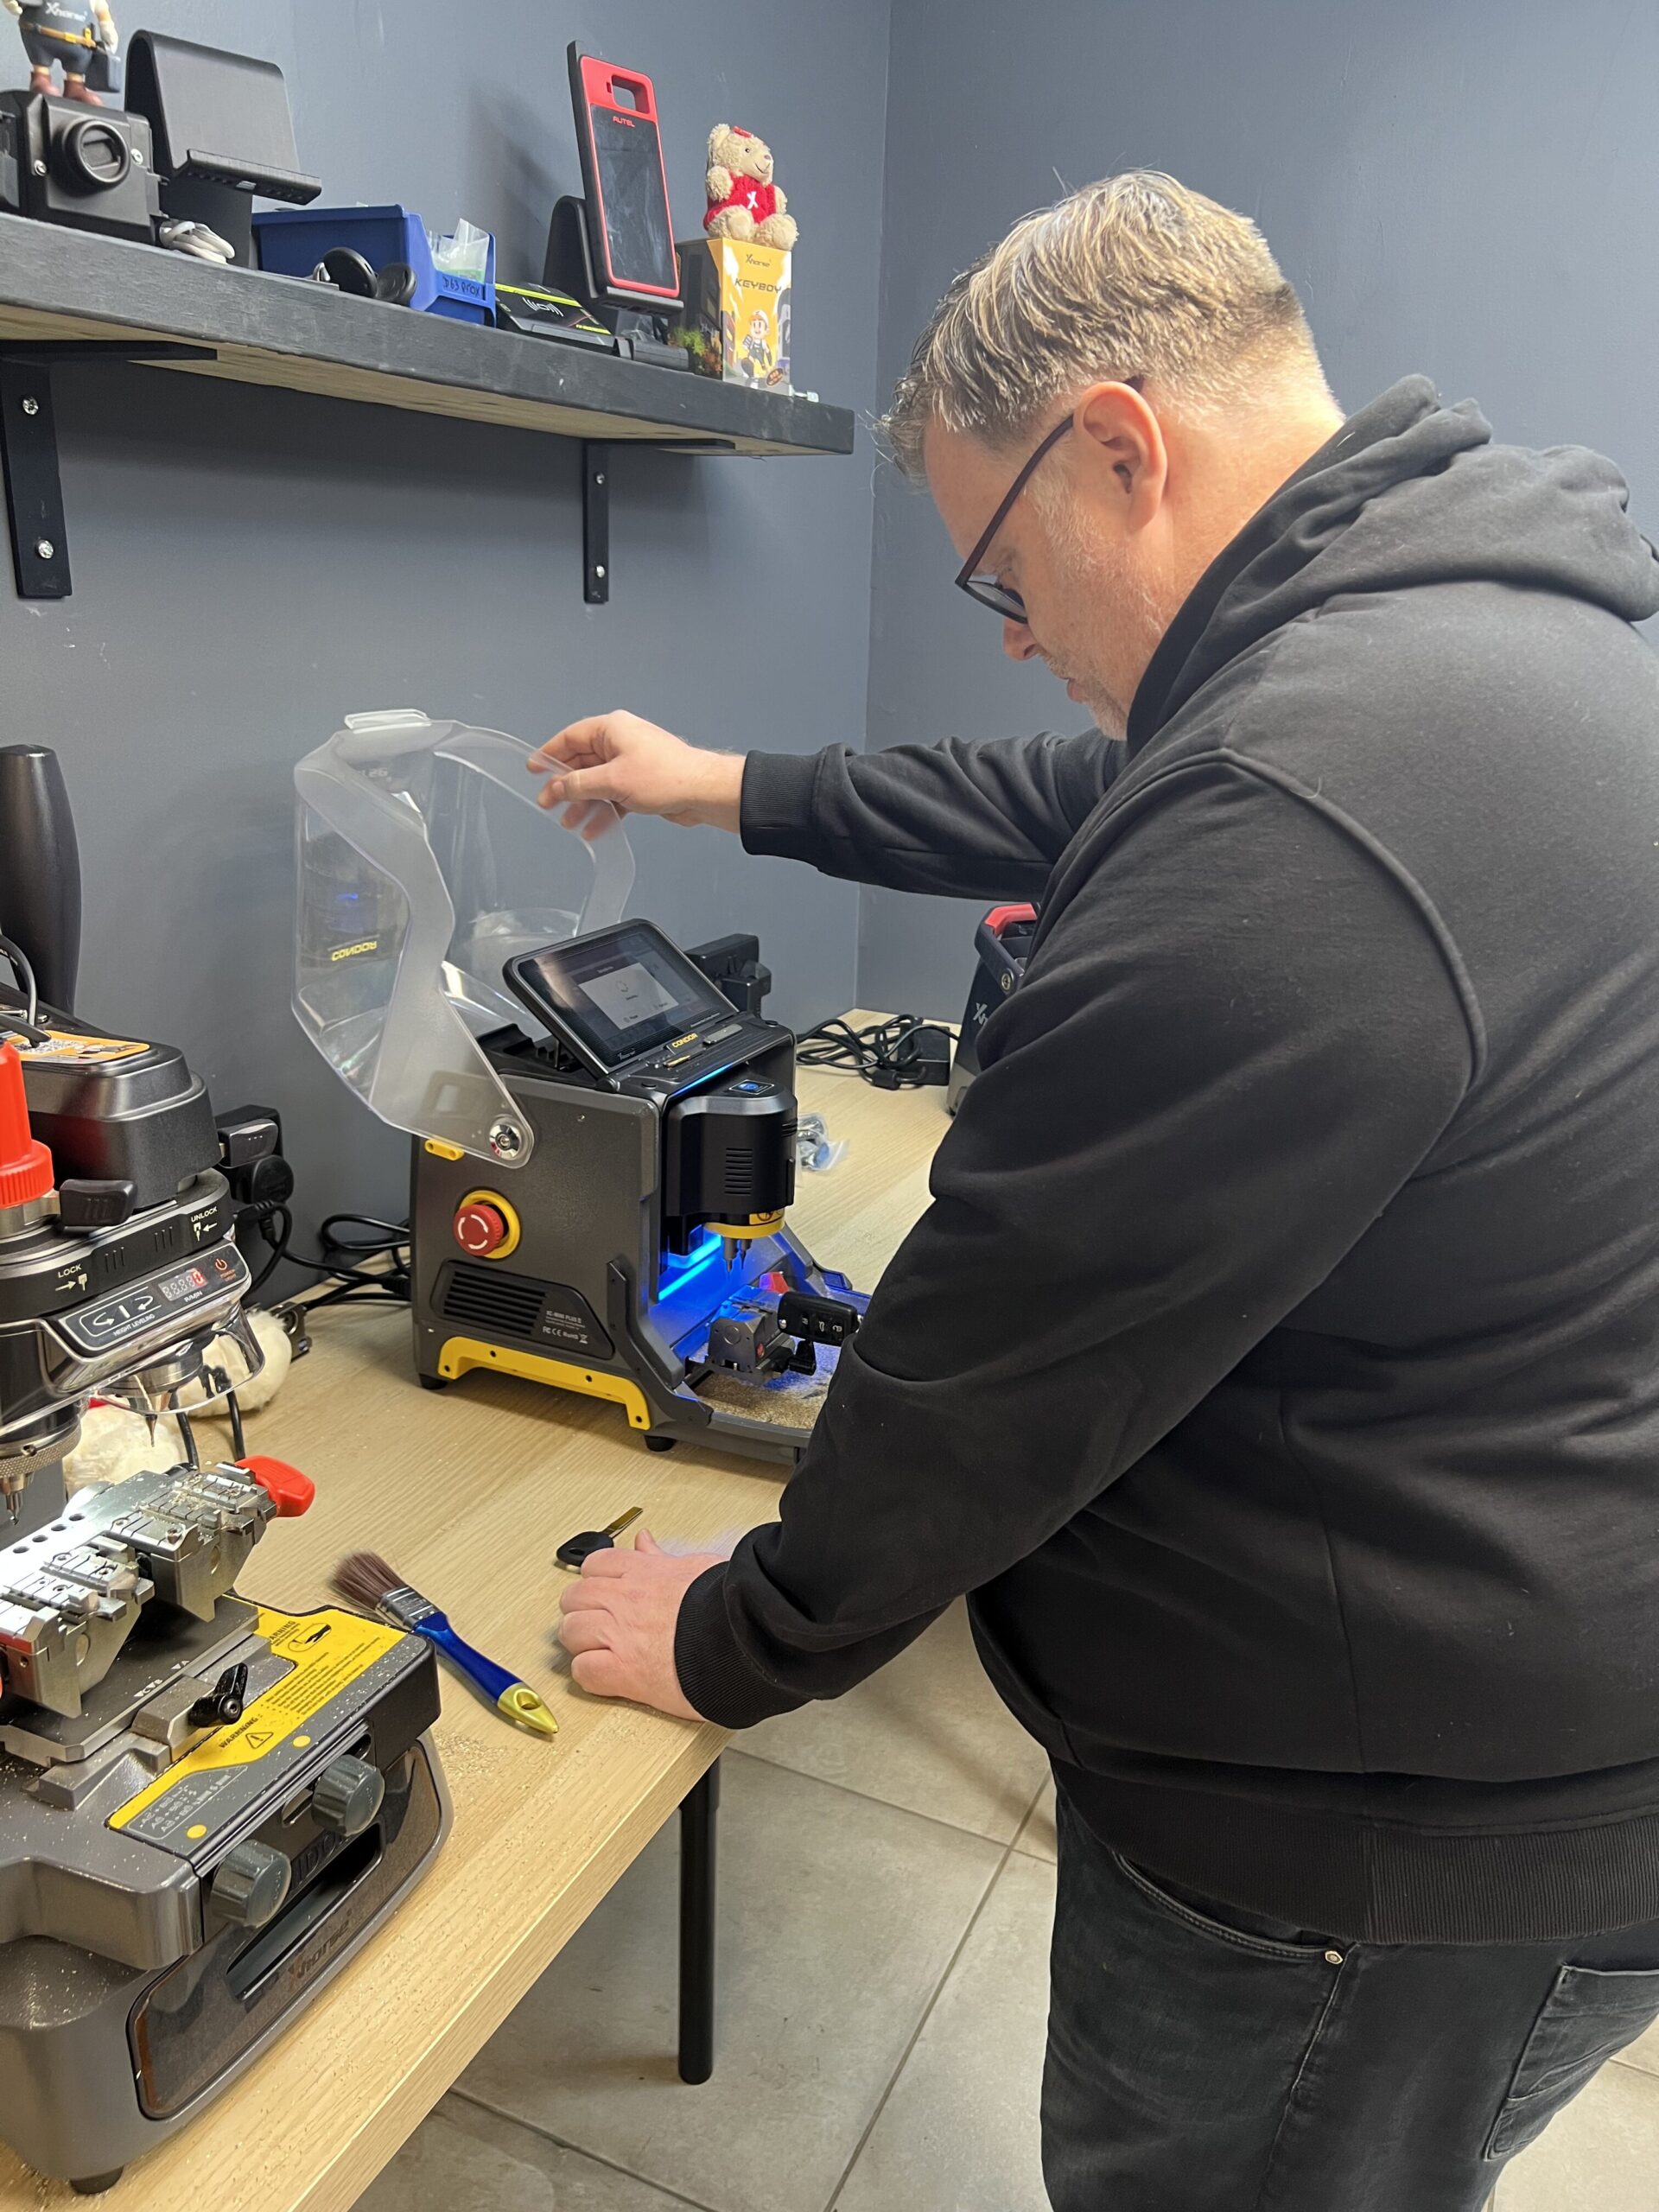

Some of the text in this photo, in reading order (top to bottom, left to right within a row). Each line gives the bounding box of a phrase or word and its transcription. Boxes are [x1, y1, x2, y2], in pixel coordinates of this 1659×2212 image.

[613, 116, 636, 128] AUTEL
[734, 278, 781, 294] KEYBOY
[671, 1033, 699, 1048] CONDOR
[190, 1206, 218, 1223] UNLOCK
[58, 1263, 82, 1278] LOCK
[113, 1313, 156, 1337] HEIGHT LEVELING
[270, 1621, 296, 1640] ARNING
[288, 1918, 351, 1985] Xhorse
